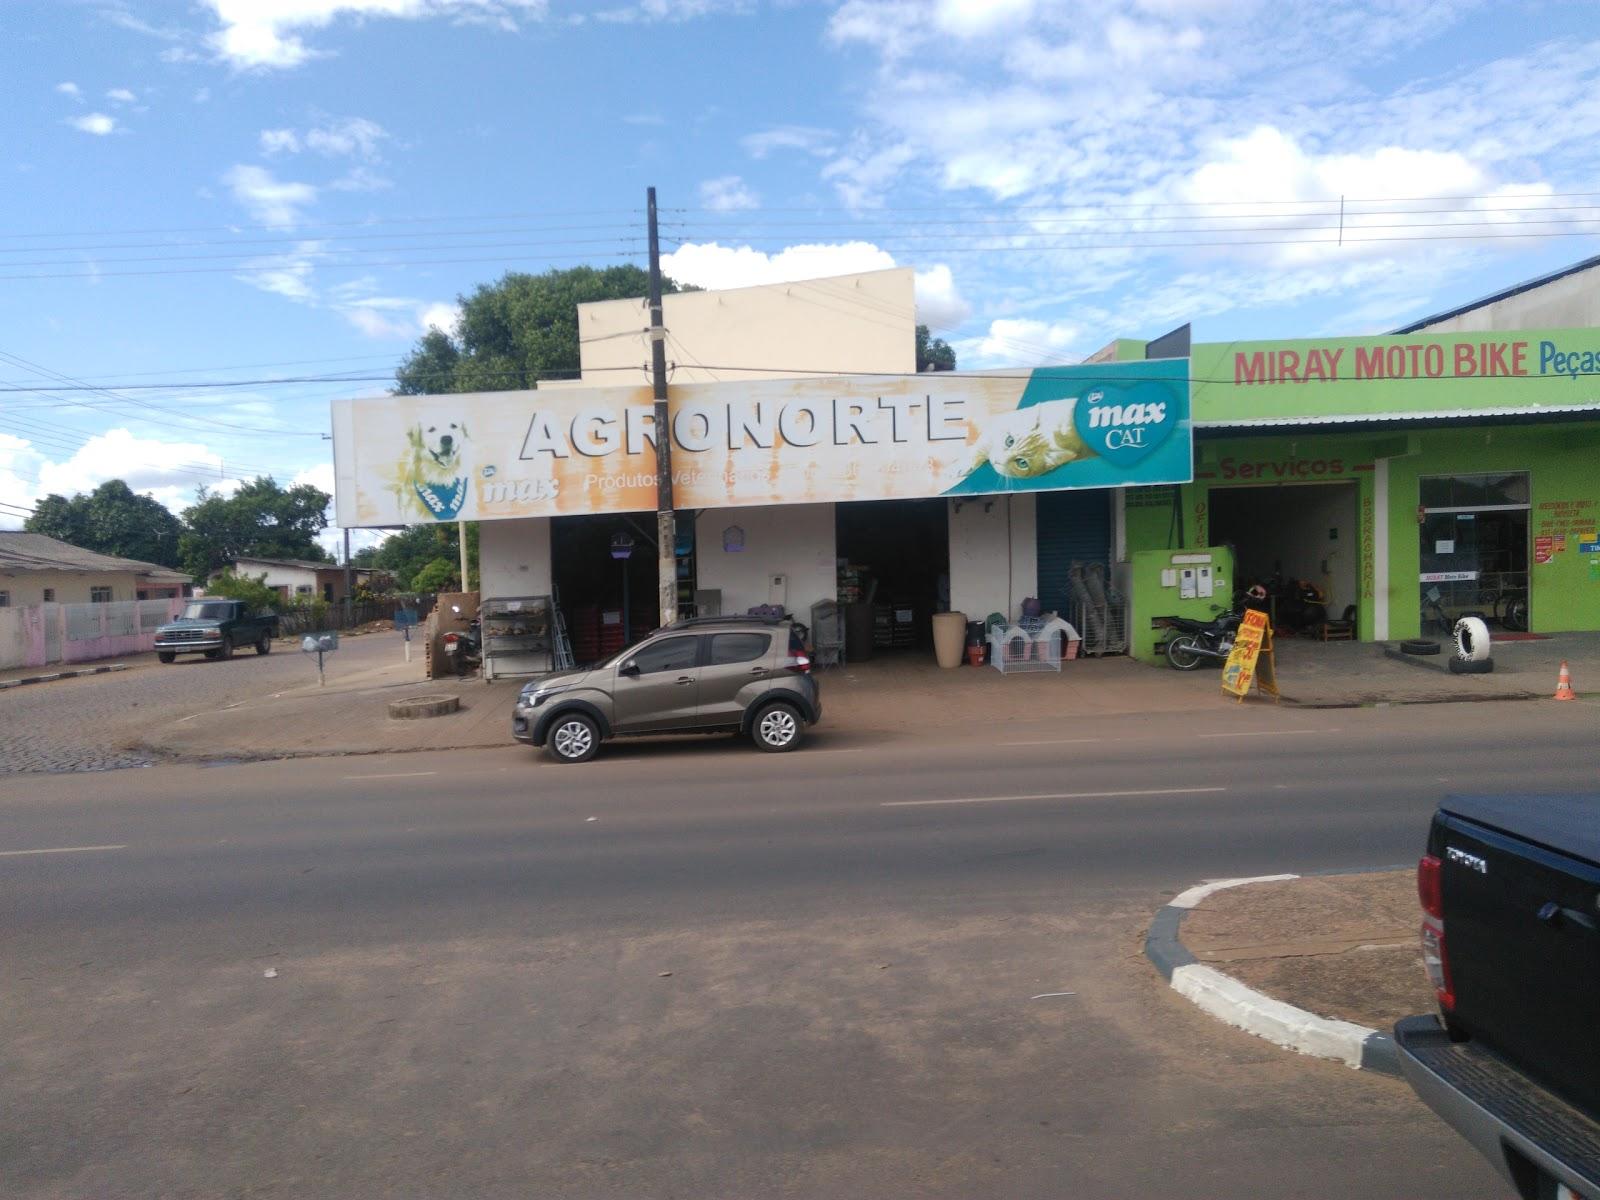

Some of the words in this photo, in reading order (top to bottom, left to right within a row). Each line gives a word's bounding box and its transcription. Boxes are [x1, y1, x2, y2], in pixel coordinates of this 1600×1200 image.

[1234, 347, 1344, 385] MIRAY
[1355, 344, 1444, 379] MOTO
[1454, 341, 1528, 377] BIKE
[519, 391, 968, 460] AGRONORTE
[1088, 402, 1166, 428] max
[1105, 427, 1149, 450] CAT
[586, 471, 660, 489] Produtos
[1220, 456, 1344, 480] Serviços
[482, 479, 560, 503] max
